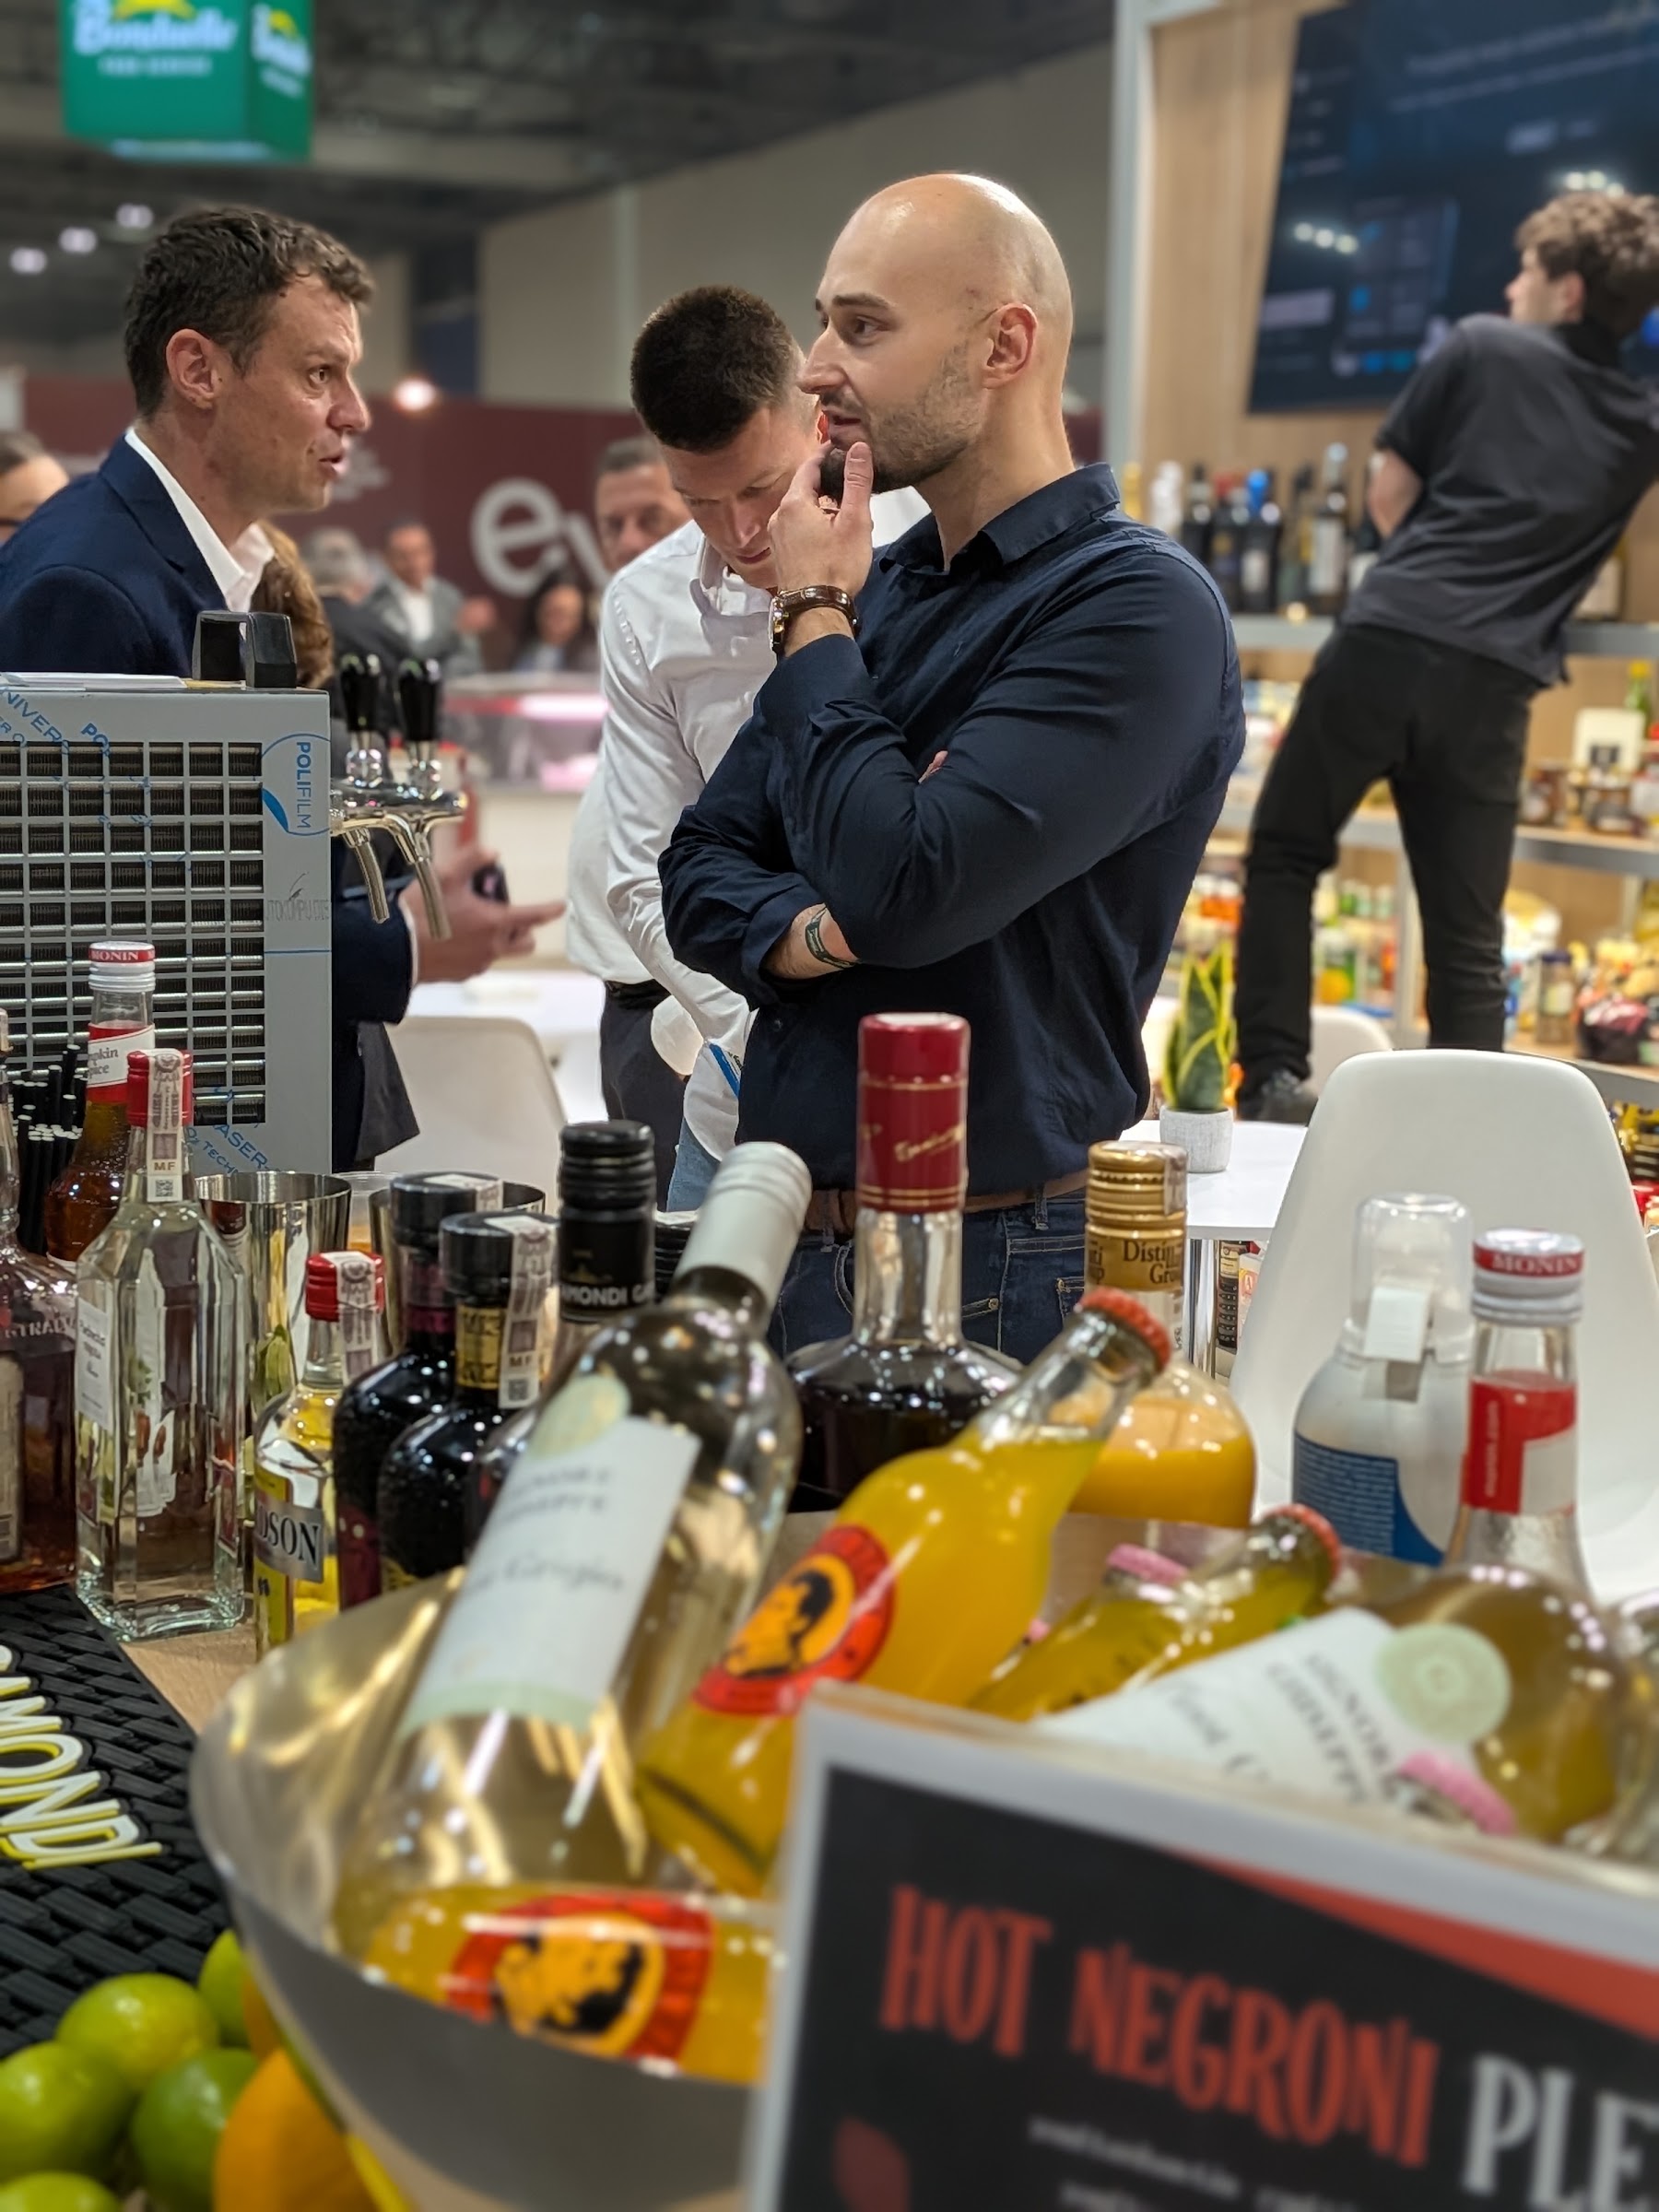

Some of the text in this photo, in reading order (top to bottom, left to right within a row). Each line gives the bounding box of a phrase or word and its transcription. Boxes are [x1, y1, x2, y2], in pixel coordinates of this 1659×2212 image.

[296, 741, 312, 829] POLIFILM
[154, 1162, 175, 1171] MF
[880, 1885, 1053, 2057] HOT
[1070, 1943, 1440, 2167] NEGRONI
